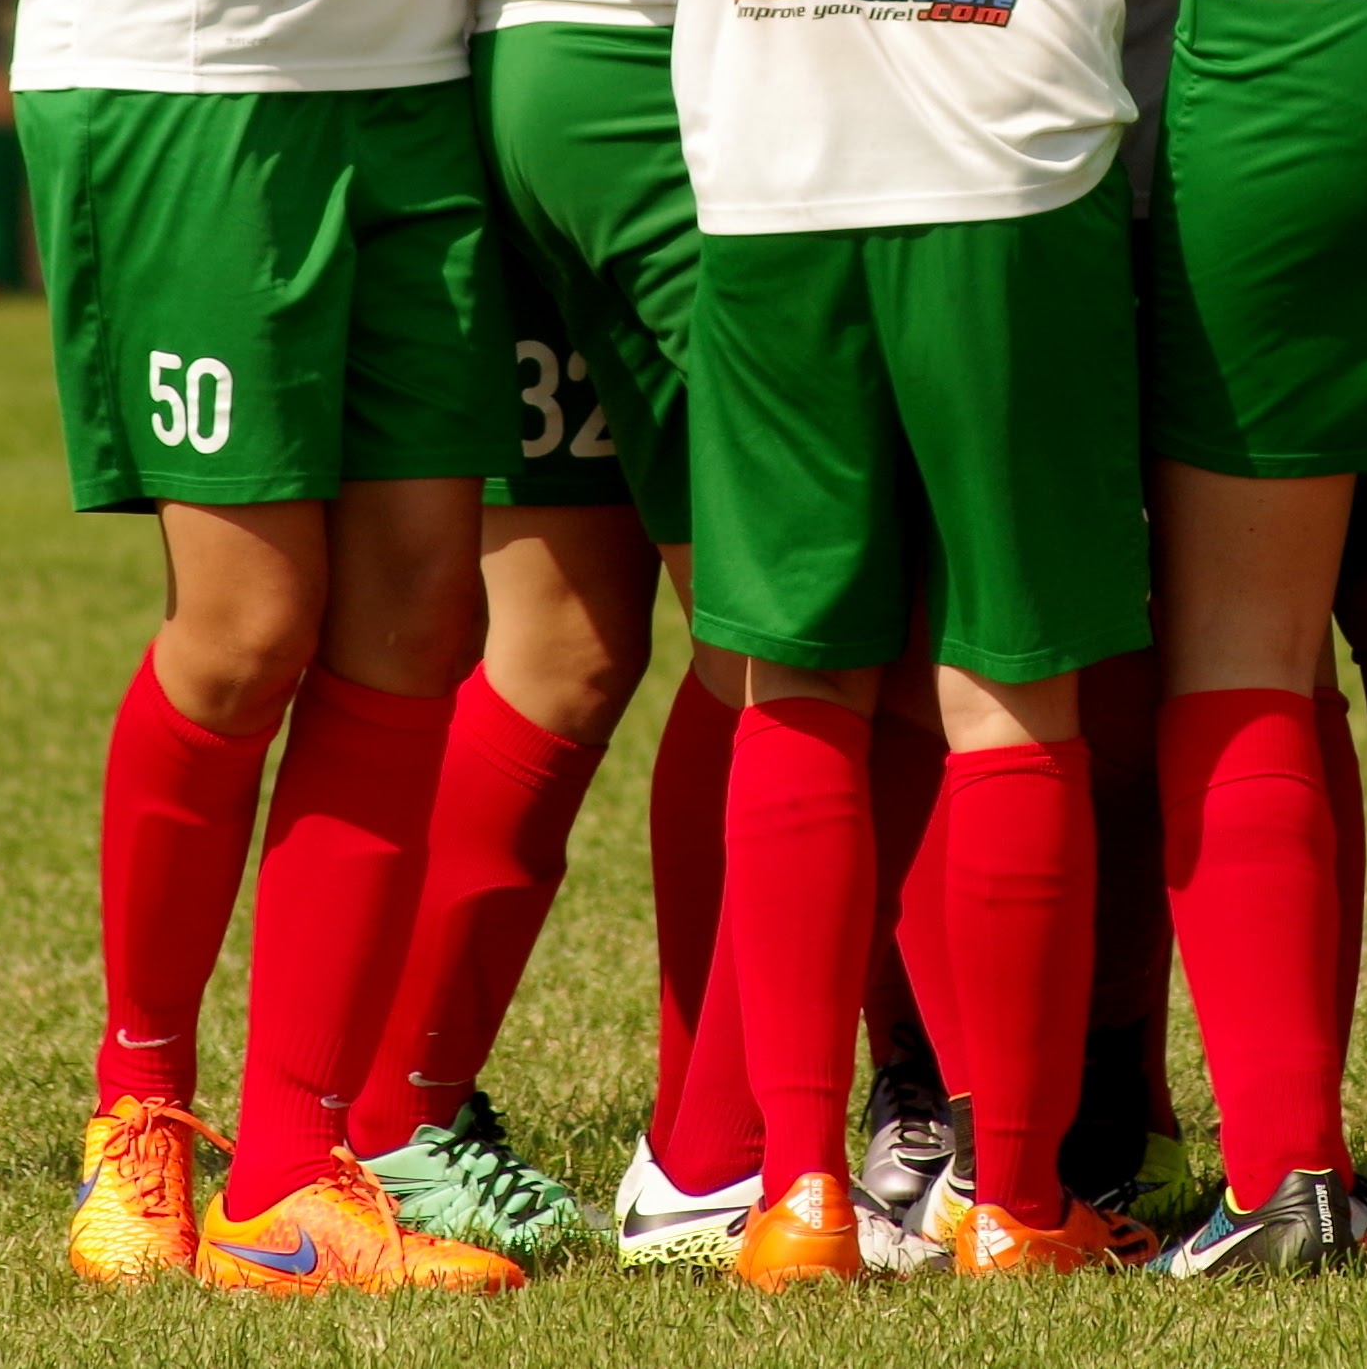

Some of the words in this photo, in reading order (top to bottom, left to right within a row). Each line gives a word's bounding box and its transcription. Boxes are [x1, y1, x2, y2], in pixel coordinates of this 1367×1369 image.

[812, 4, 863, 20] your
[868, 6, 914, 21] life!
[917, 2, 1012, 28] .com
[149, 350, 233, 455] 50
[515, 339, 618, 458] 32
[809, 1179, 824, 1230] adidas
